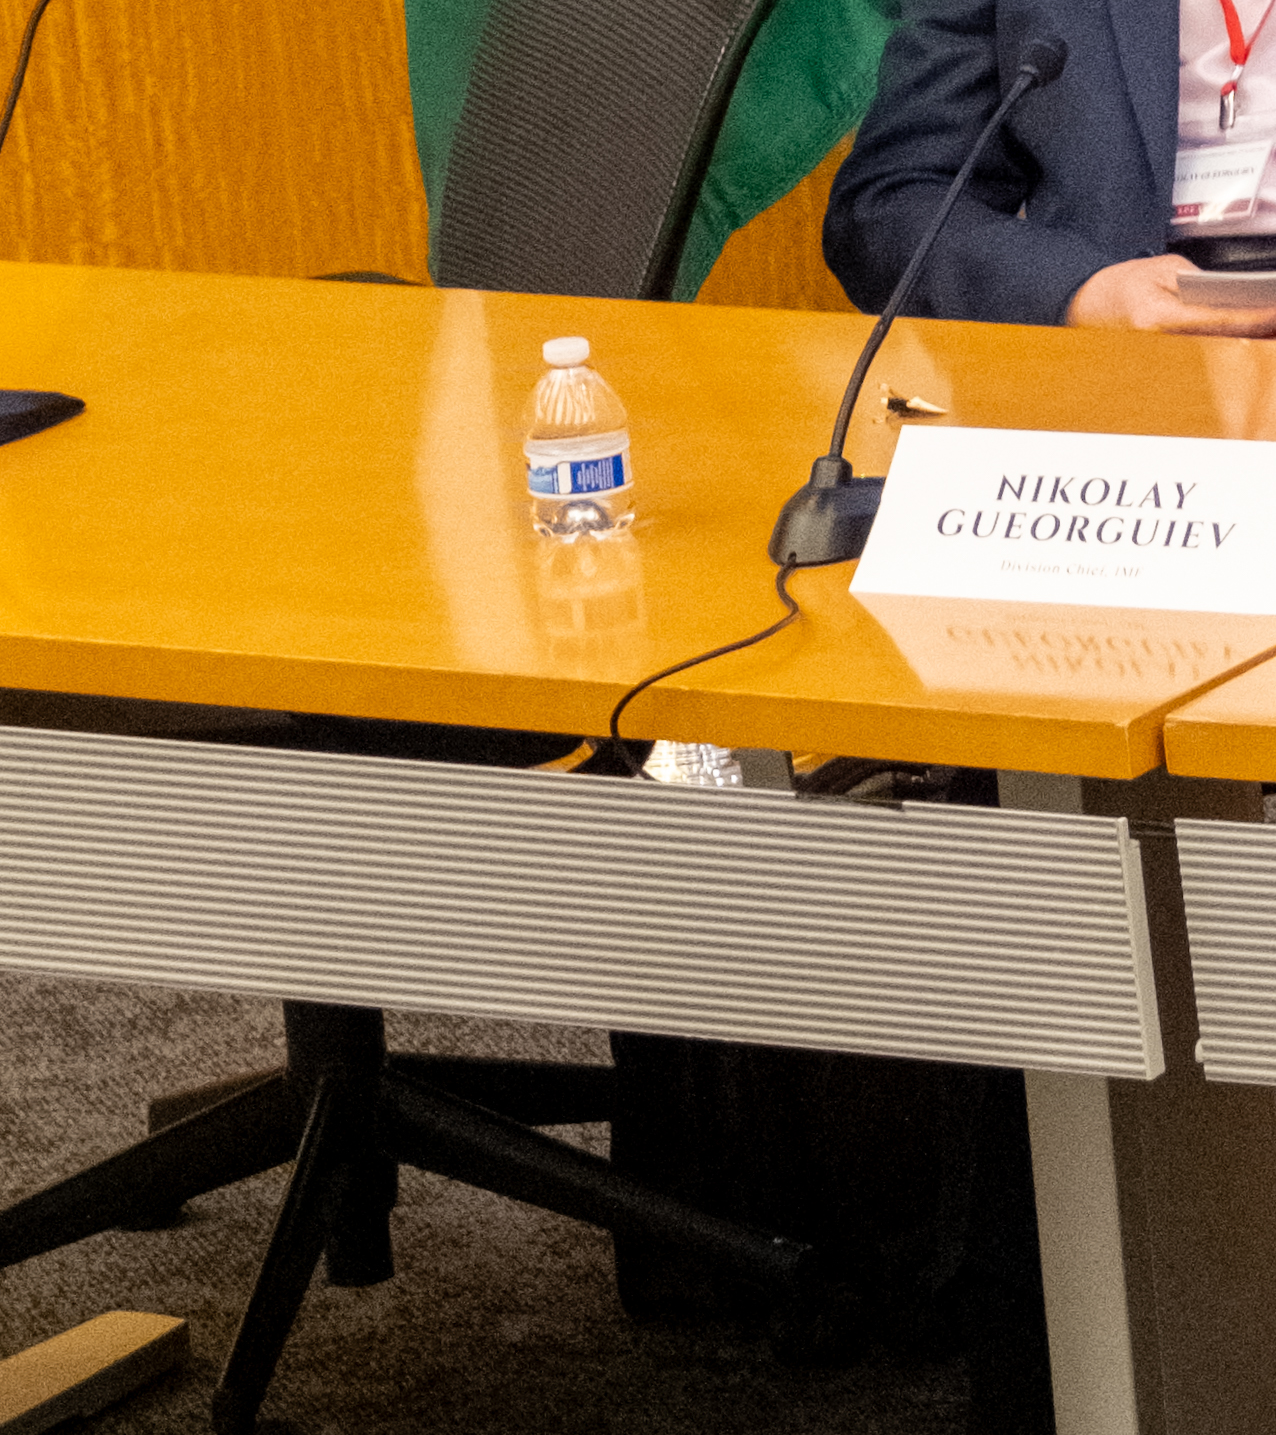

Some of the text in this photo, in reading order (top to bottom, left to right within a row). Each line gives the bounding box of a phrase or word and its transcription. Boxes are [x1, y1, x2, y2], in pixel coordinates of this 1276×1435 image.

[996, 473, 1198, 510] NIKOLAY
[936, 508, 1237, 550] GUEORGUIEV
[1000, 559, 1061, 575] Division
[1115, 566, 1144, 578] IMF
